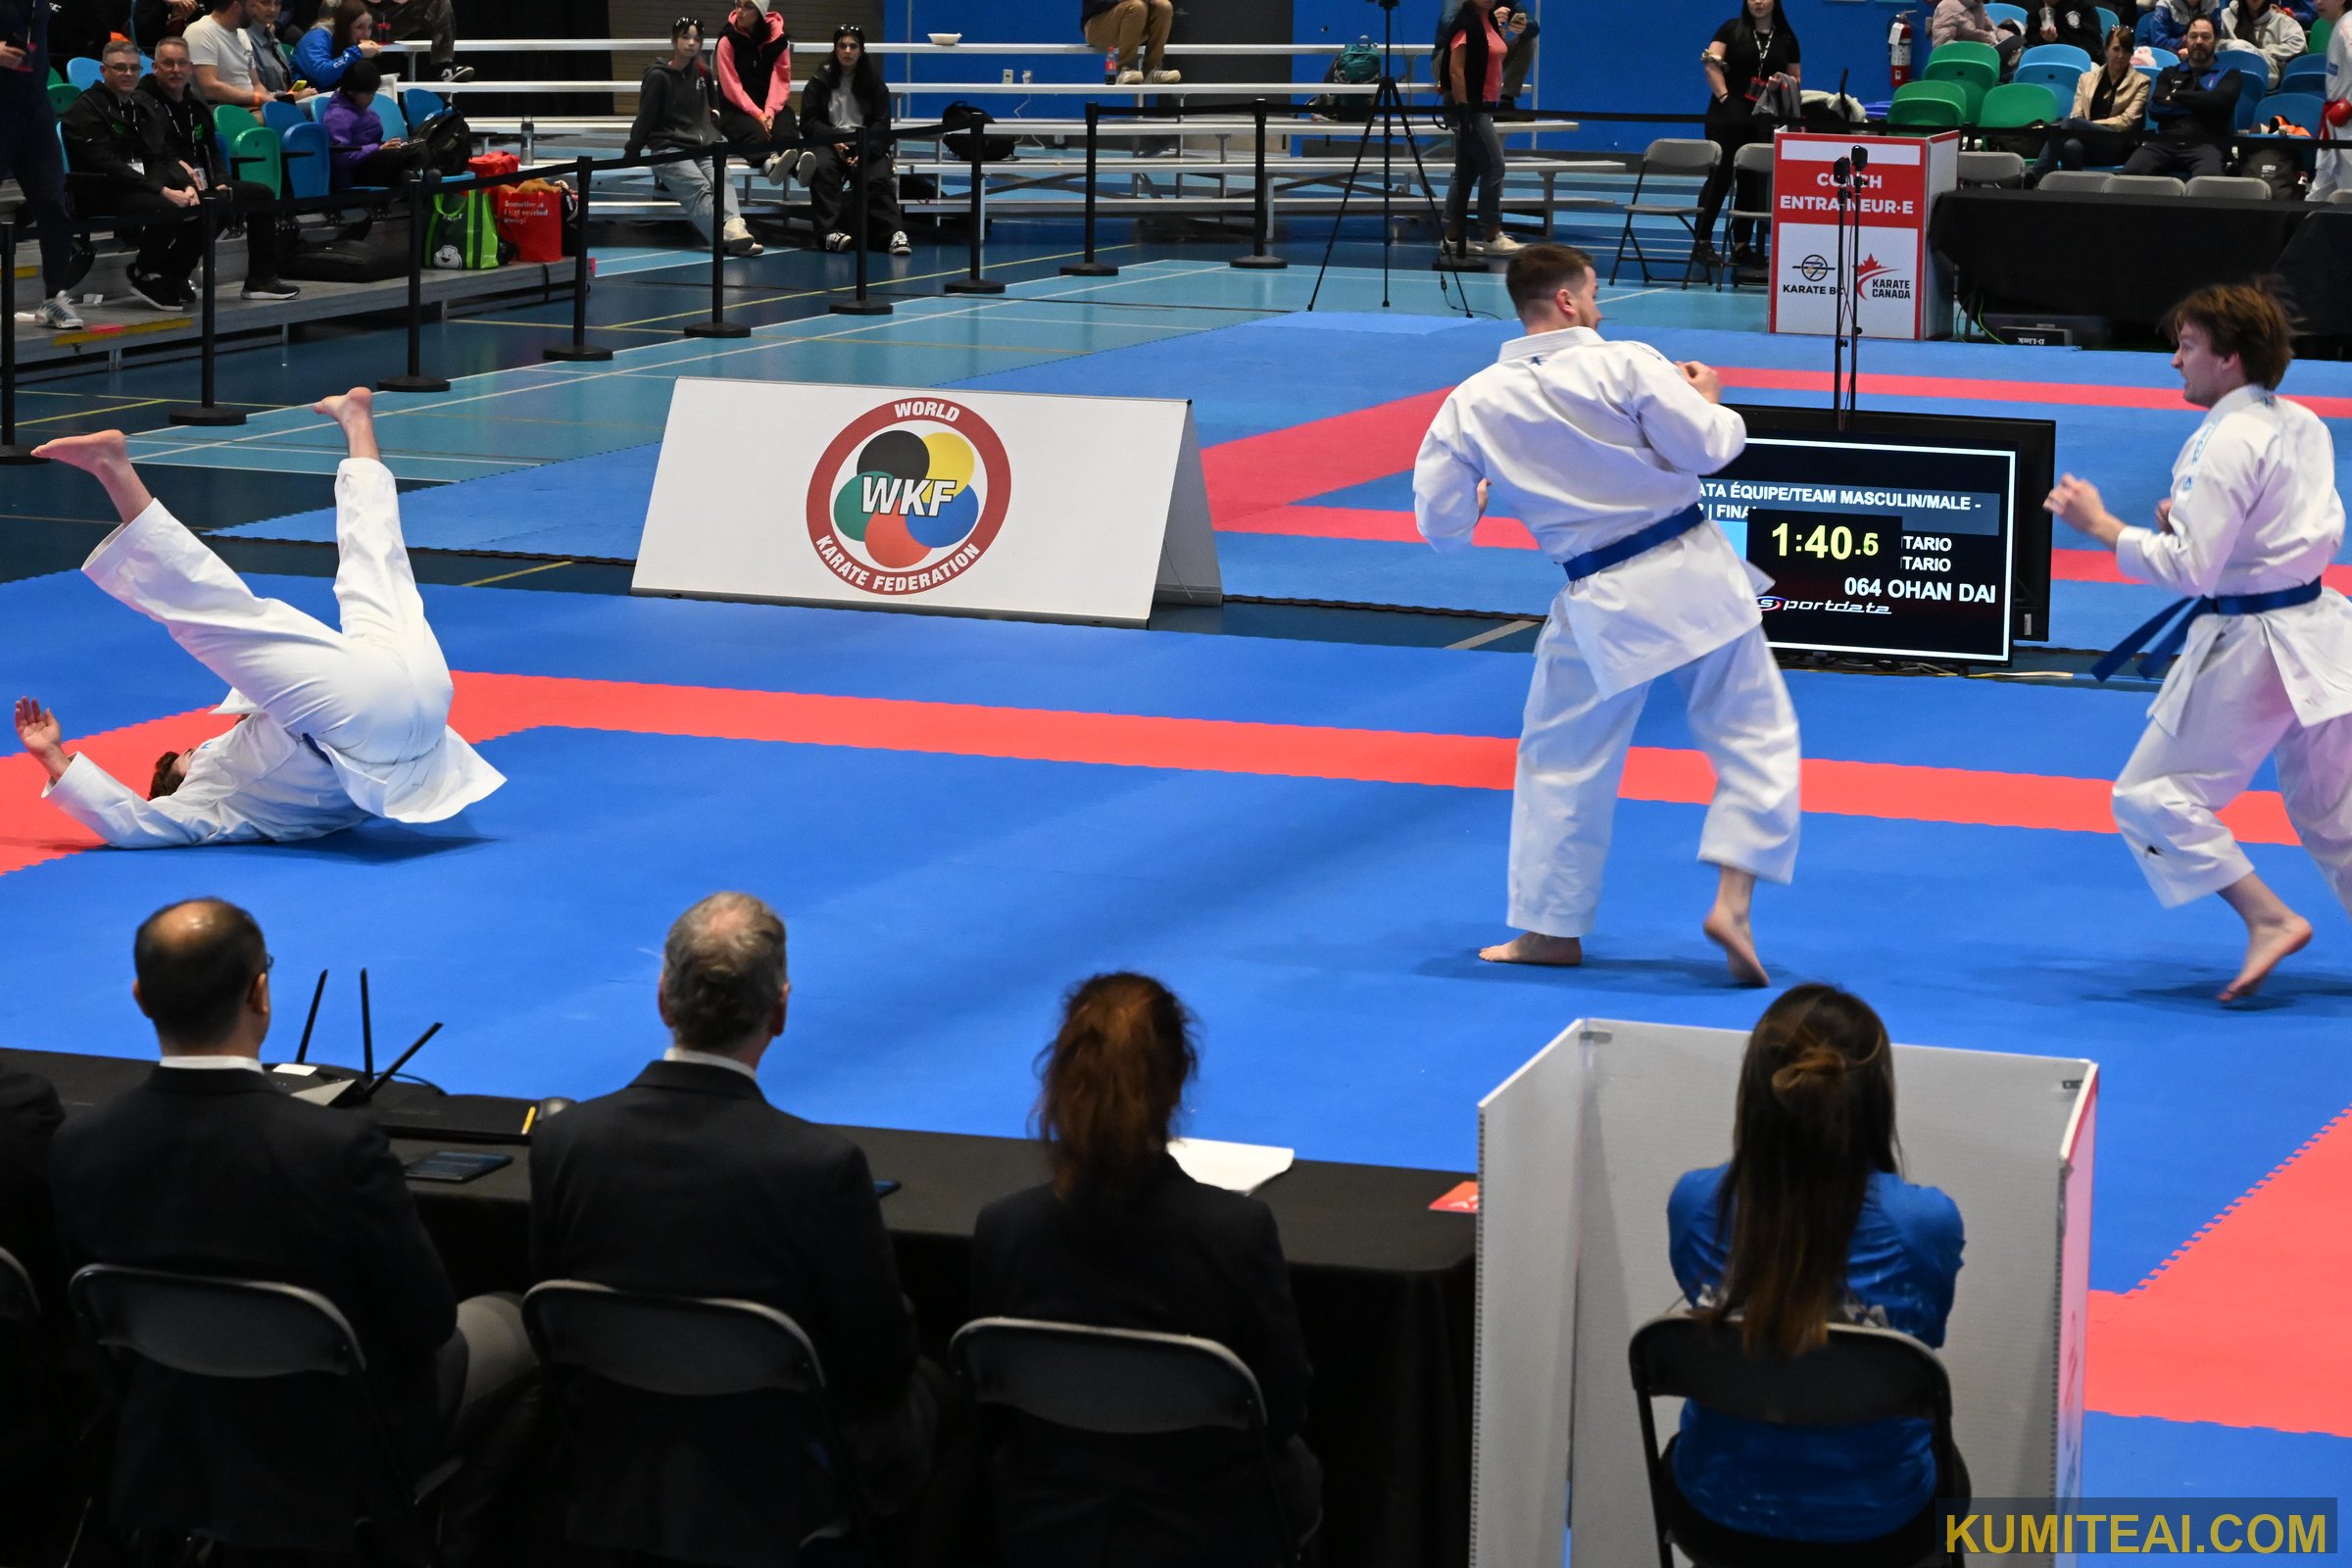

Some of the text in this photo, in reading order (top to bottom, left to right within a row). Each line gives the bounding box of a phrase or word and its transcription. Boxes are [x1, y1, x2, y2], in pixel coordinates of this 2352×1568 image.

[1783, 284, 1826, 295] KARATE
[1873, 278, 1910, 289] KARATE
[1872, 288, 1911, 300] CANADA
[2017, 337, 2045, 346] D-Link
[894, 401, 960, 422] WORLD
[861, 475, 957, 517] WKF
[1699, 482, 1727, 498] ATA
[1730, 481, 1837, 504] ÉQUIPE/TEAM
[1839, 490, 1972, 511] MASCULIN/MALE
[1901, 536, 1952, 552] TARIO
[815, 534, 981, 592] KARATE FEDERATION
[1900, 556, 1951, 572] TARIO
[1844, 577, 1996, 604] 064 OHAN DAI
